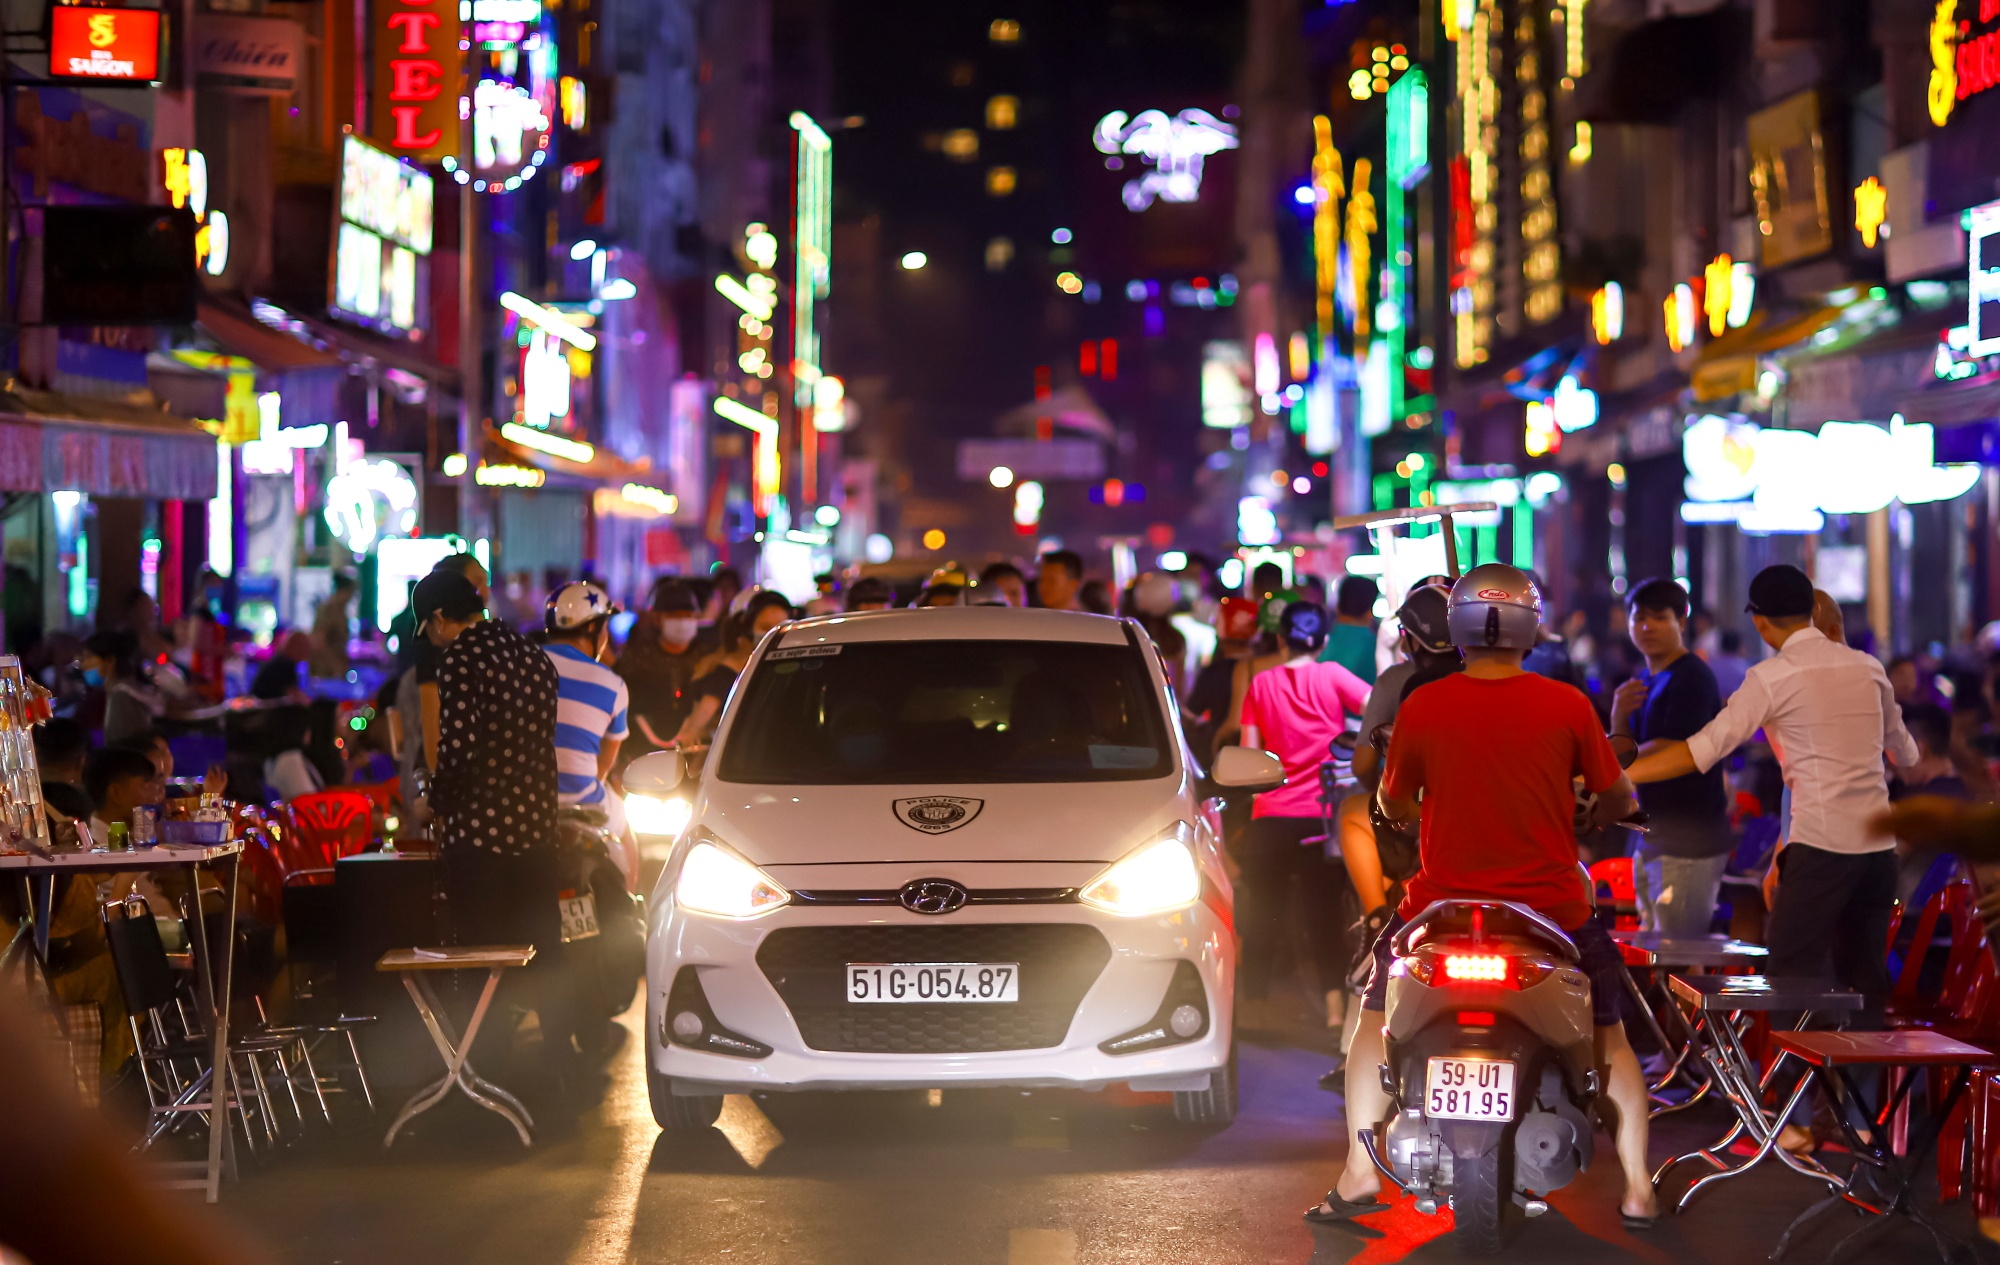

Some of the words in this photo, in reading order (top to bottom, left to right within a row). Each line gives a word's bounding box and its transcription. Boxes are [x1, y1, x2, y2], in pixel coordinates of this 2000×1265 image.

[69, 57, 135, 77] SAIGON
[388, 0, 443, 148] TEL
[852, 968, 1013, 999] 51G-054.87
[1441, 1061, 1500, 1088] 59-U1
[1431, 1088, 1509, 1117] 581.95
